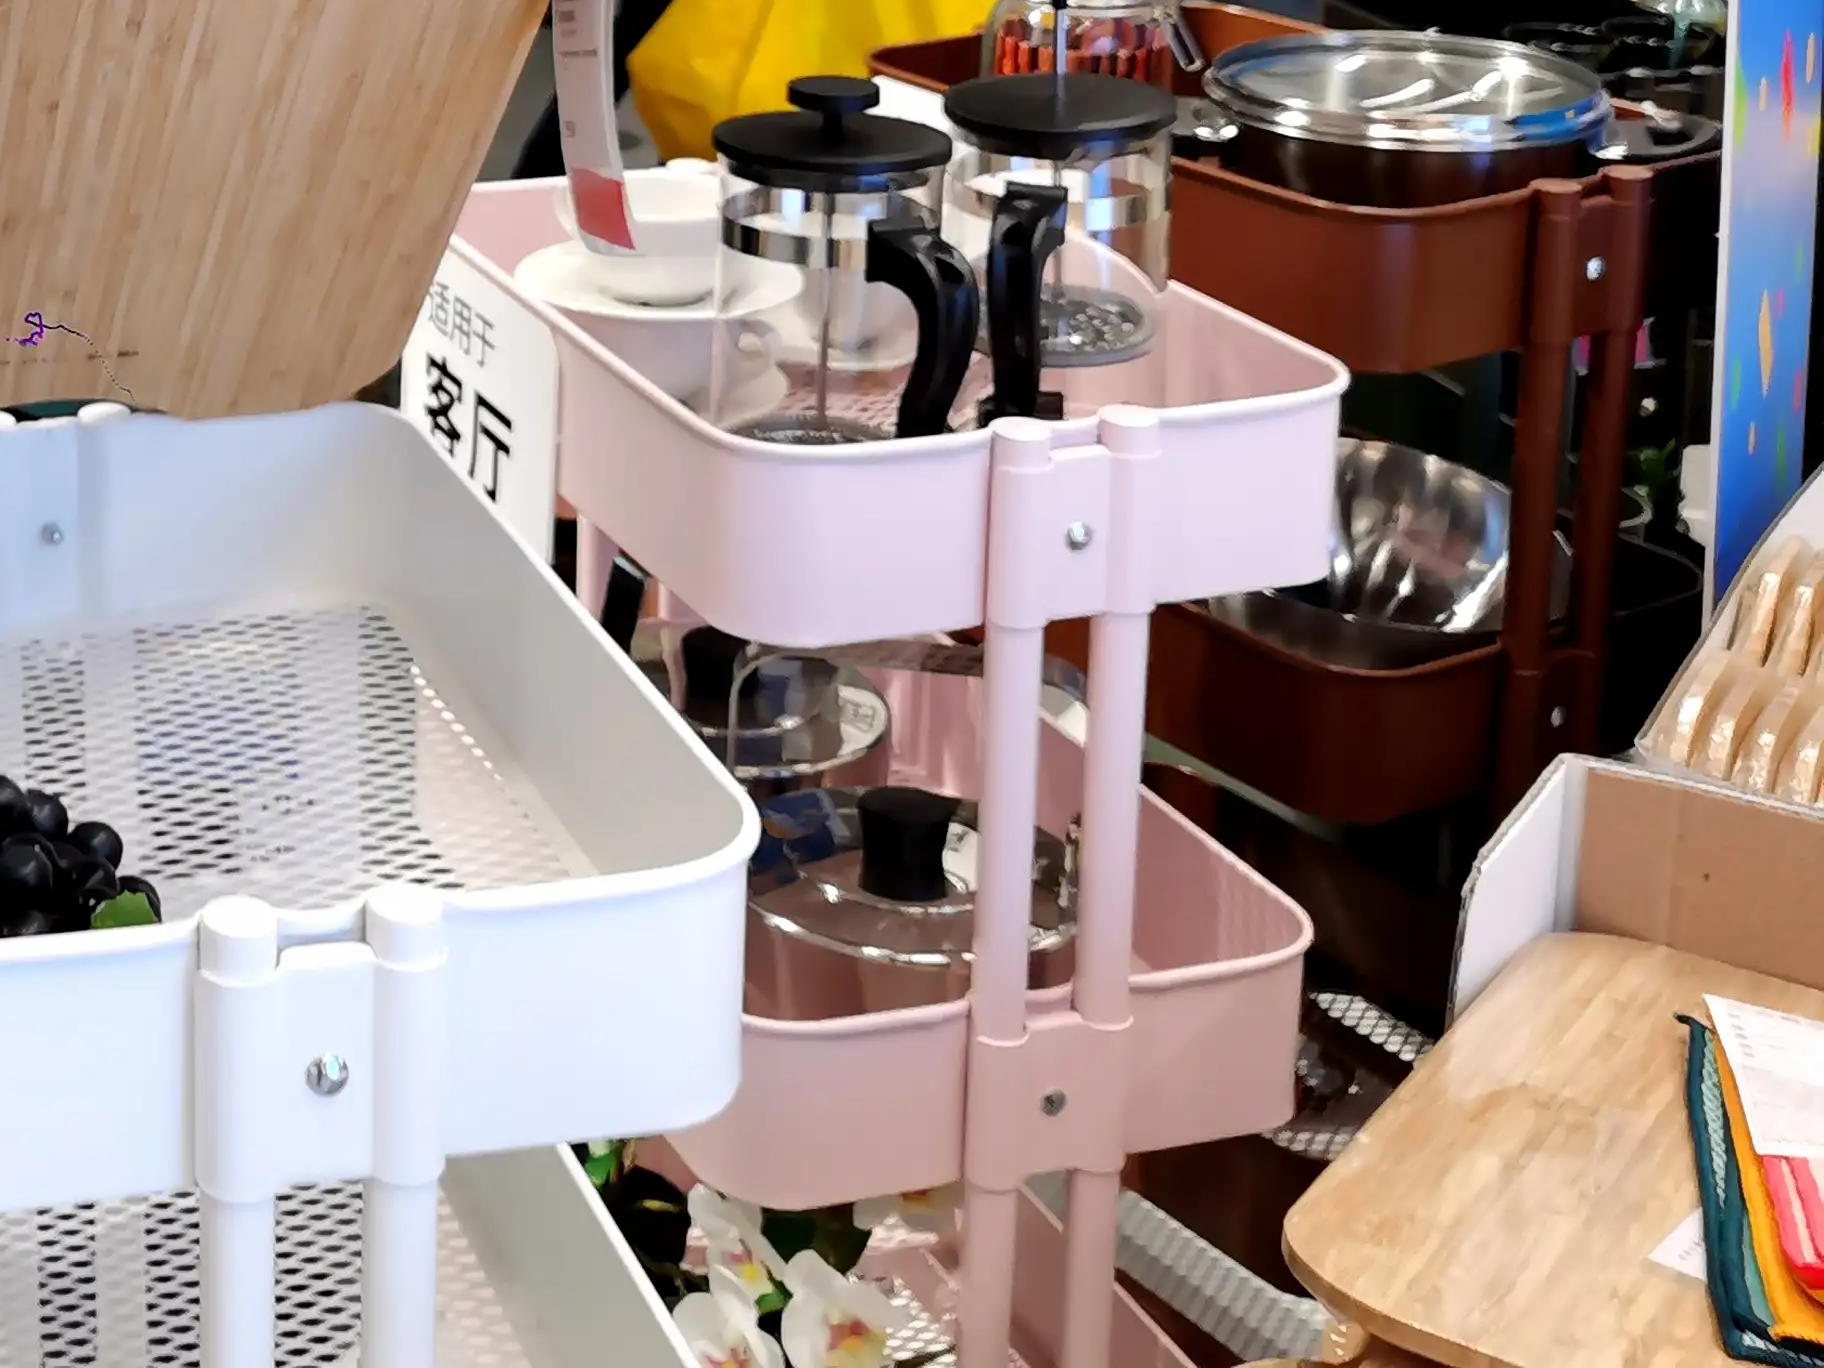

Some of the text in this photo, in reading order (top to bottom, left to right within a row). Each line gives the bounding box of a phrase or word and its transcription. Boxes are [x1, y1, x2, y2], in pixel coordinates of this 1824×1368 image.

[426, 281, 496, 368] 适用于
[424, 352, 513, 502] 客厅
